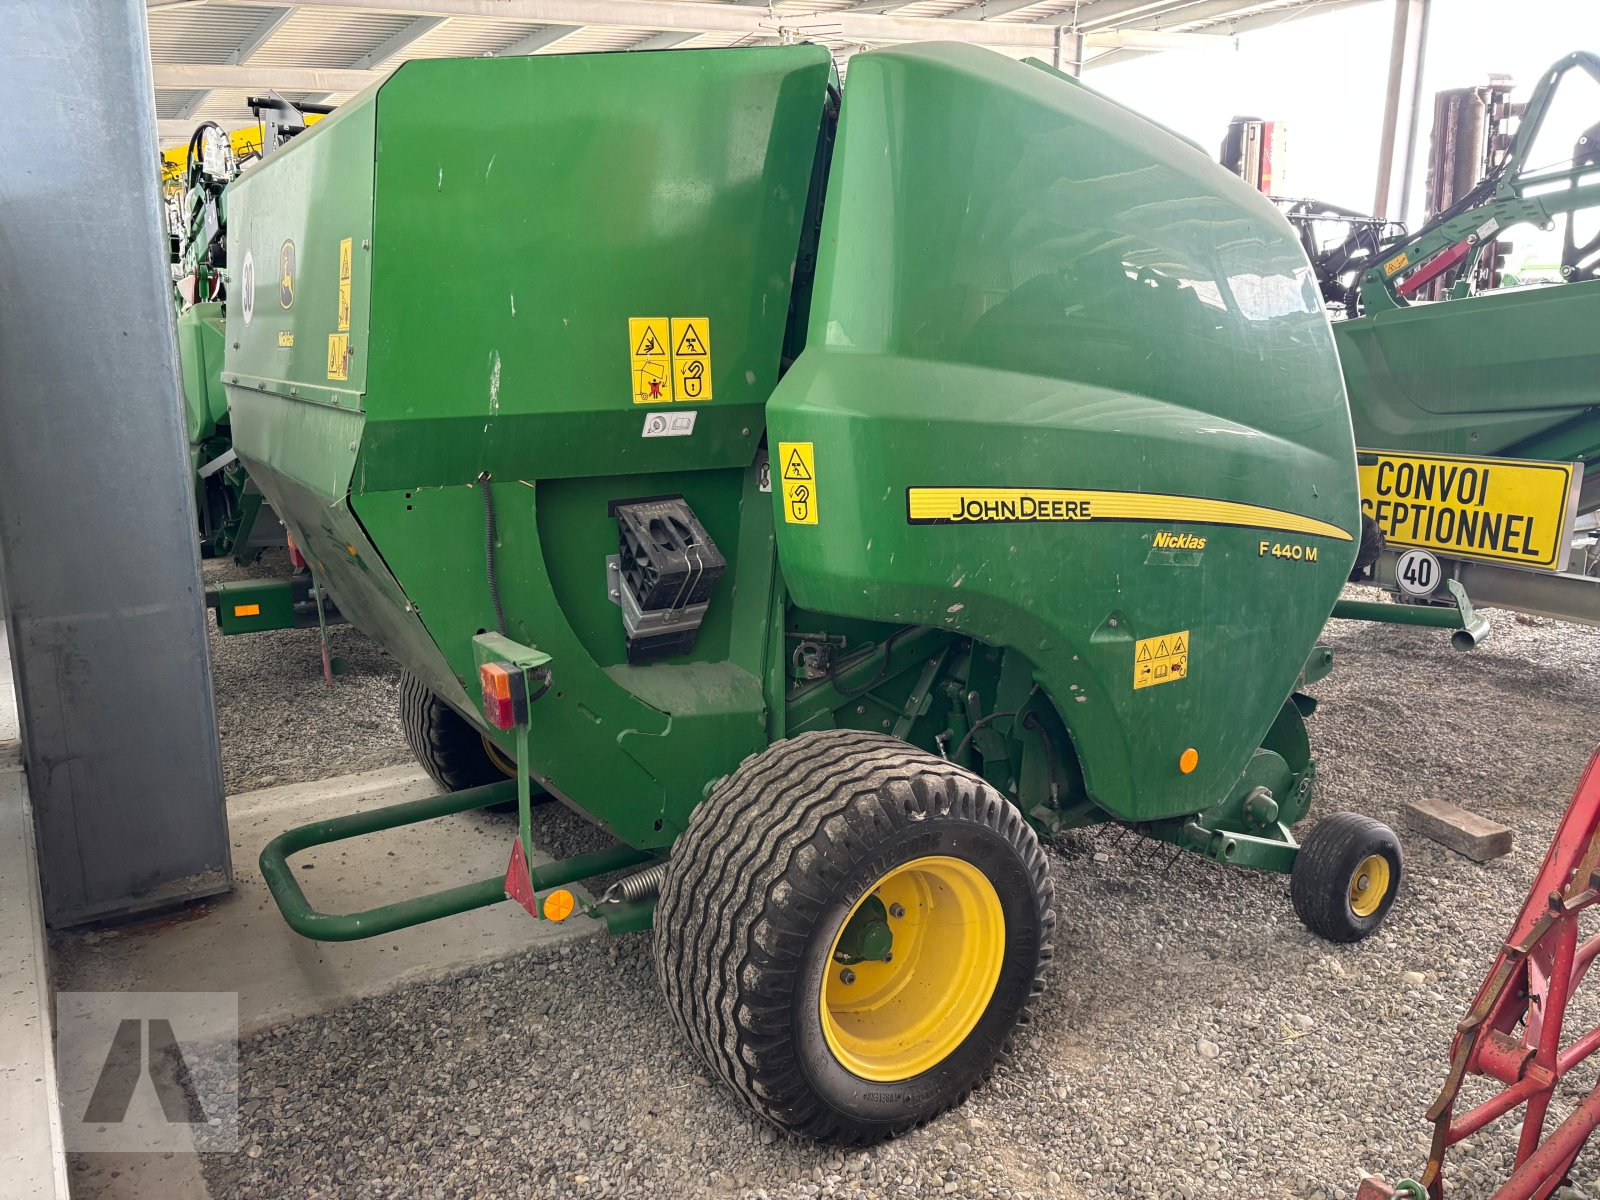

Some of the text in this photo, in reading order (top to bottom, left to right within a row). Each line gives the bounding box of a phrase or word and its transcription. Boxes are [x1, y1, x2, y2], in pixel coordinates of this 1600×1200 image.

[244, 263, 252, 312] 30
[1376, 461, 1489, 506] CONVOI
[1153, 532, 1206, 549] Nicklas
[1259, 541, 1318, 562] F 440 M
[1402, 556, 1431, 587] 40
